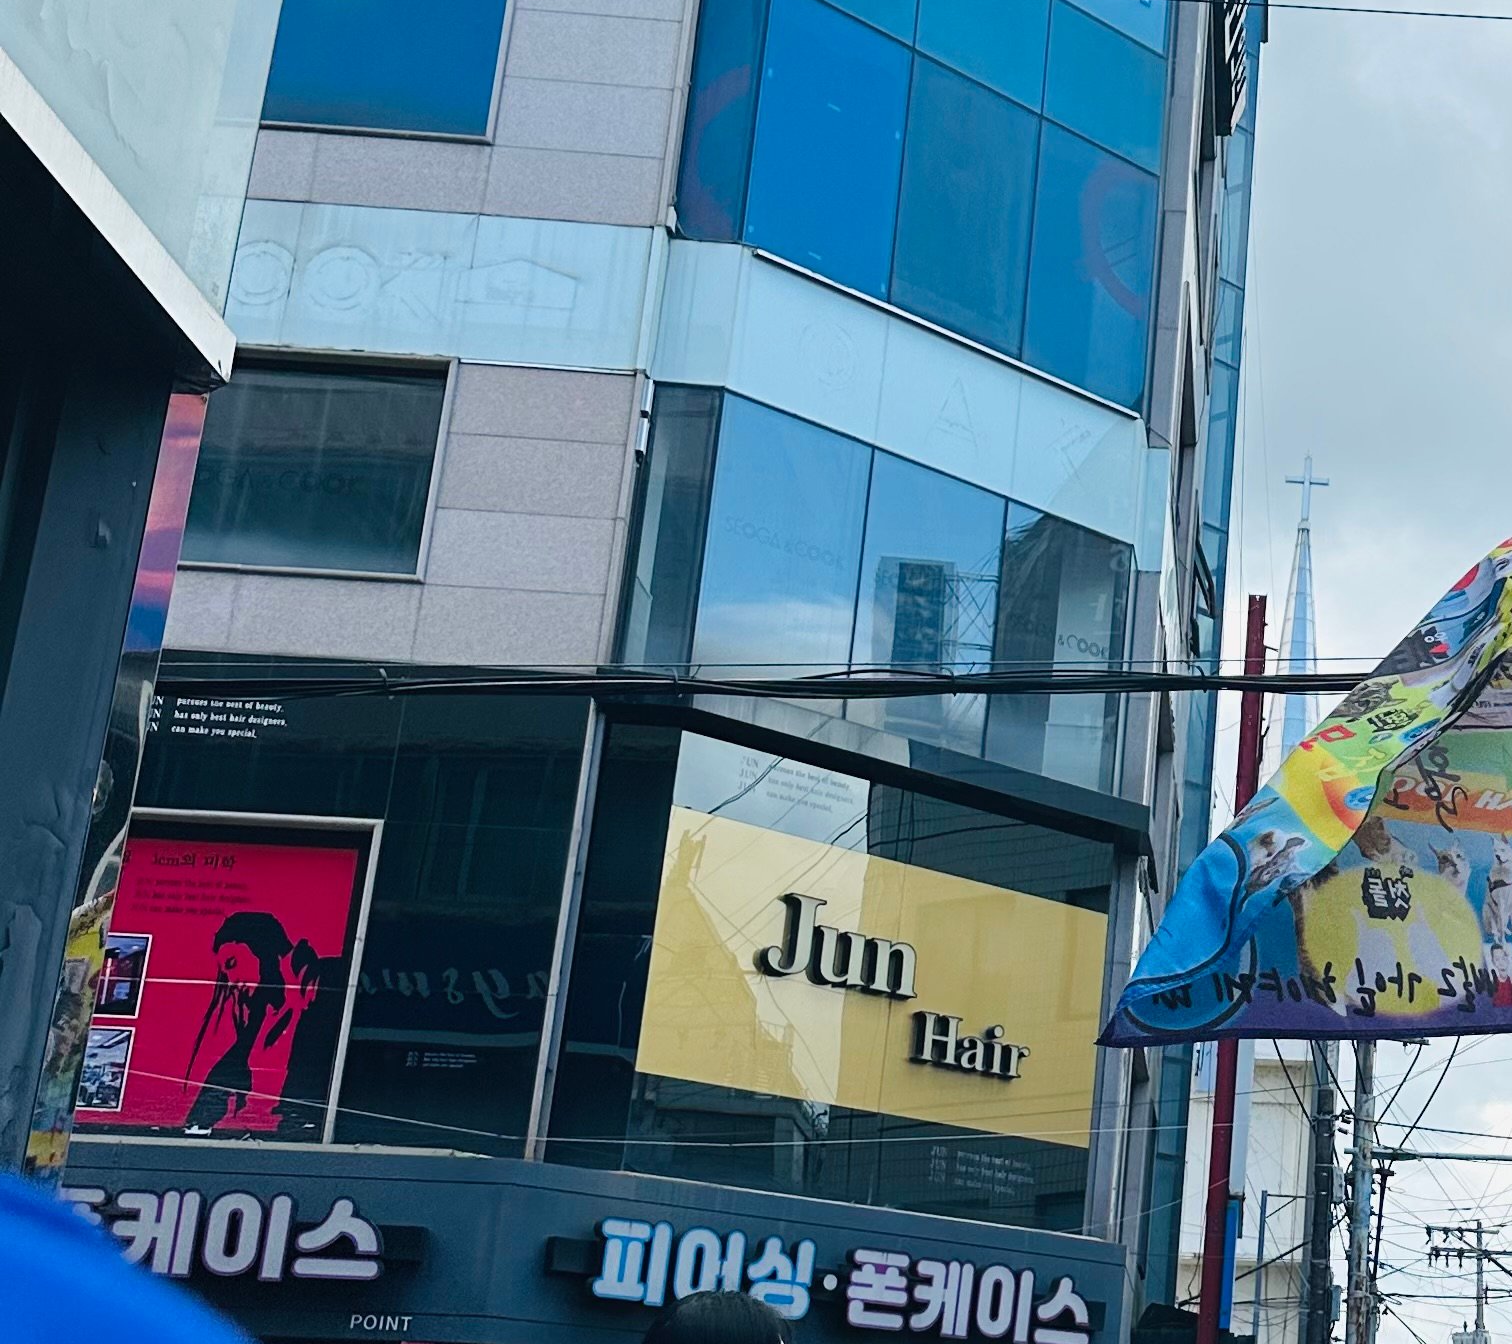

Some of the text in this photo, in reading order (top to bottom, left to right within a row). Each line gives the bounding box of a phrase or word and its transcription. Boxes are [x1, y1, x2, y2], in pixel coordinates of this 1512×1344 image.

[174, 709, 188, 720] has
[190, 711, 208, 722] only
[210, 712, 227, 722] best
[229, 712, 246, 723] hair
[171, 725, 185, 733] can
[188, 725, 209, 735] make
[210, 727, 225, 737] you
[764, 892, 918, 999] Jun
[911, 1010, 1031, 1079] Hair
[349, 1313, 413, 1333] POINT
